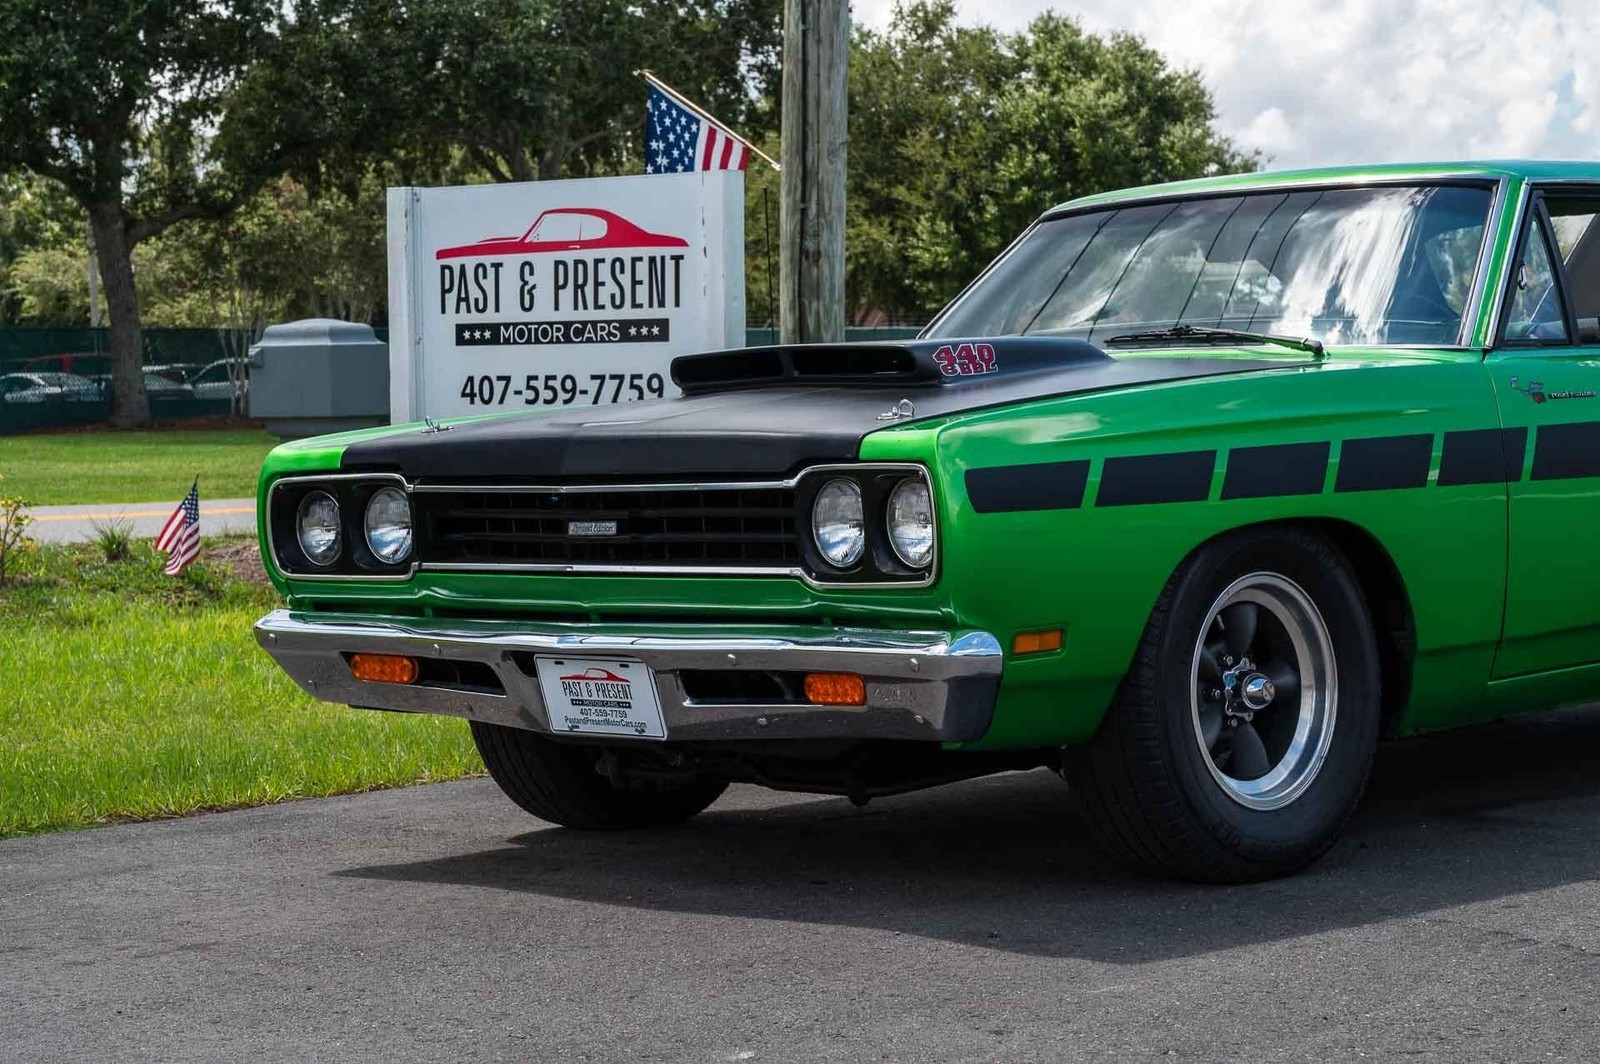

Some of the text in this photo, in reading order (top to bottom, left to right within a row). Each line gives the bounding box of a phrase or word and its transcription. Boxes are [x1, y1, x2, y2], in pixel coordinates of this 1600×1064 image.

[440, 254, 685, 315] PAST & PRESENT
[500, 322, 621, 344] MOTOR CARS
[460, 373, 665, 405] 407-559-7759
[562, 681, 633, 700] PAST & PRESENT
[564, 715, 647, 729] PastandPresentMotorCars.com
[580, 708, 627, 718] 407-559-7759
